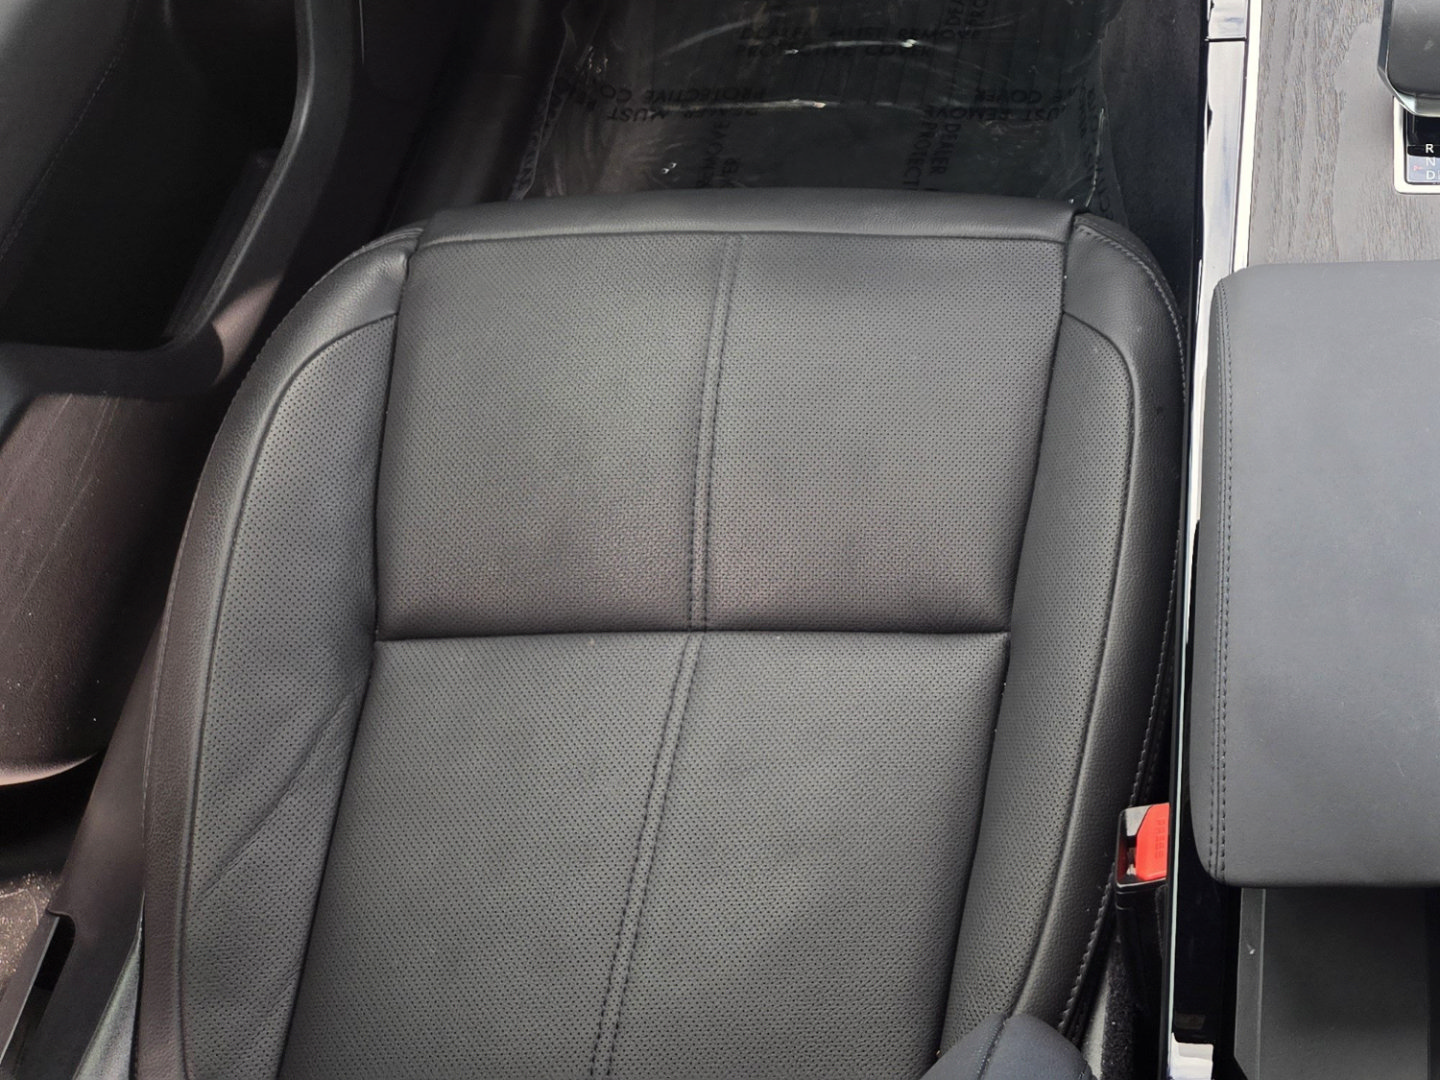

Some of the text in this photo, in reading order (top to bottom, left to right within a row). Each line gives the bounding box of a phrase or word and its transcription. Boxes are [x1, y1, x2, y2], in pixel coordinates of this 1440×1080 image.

[1425, 143, 1434, 153] R
[1426, 156, 1436, 166] N
[1426, 170, 1436, 180] D
[1154, 819, 1166, 860] PRESS
